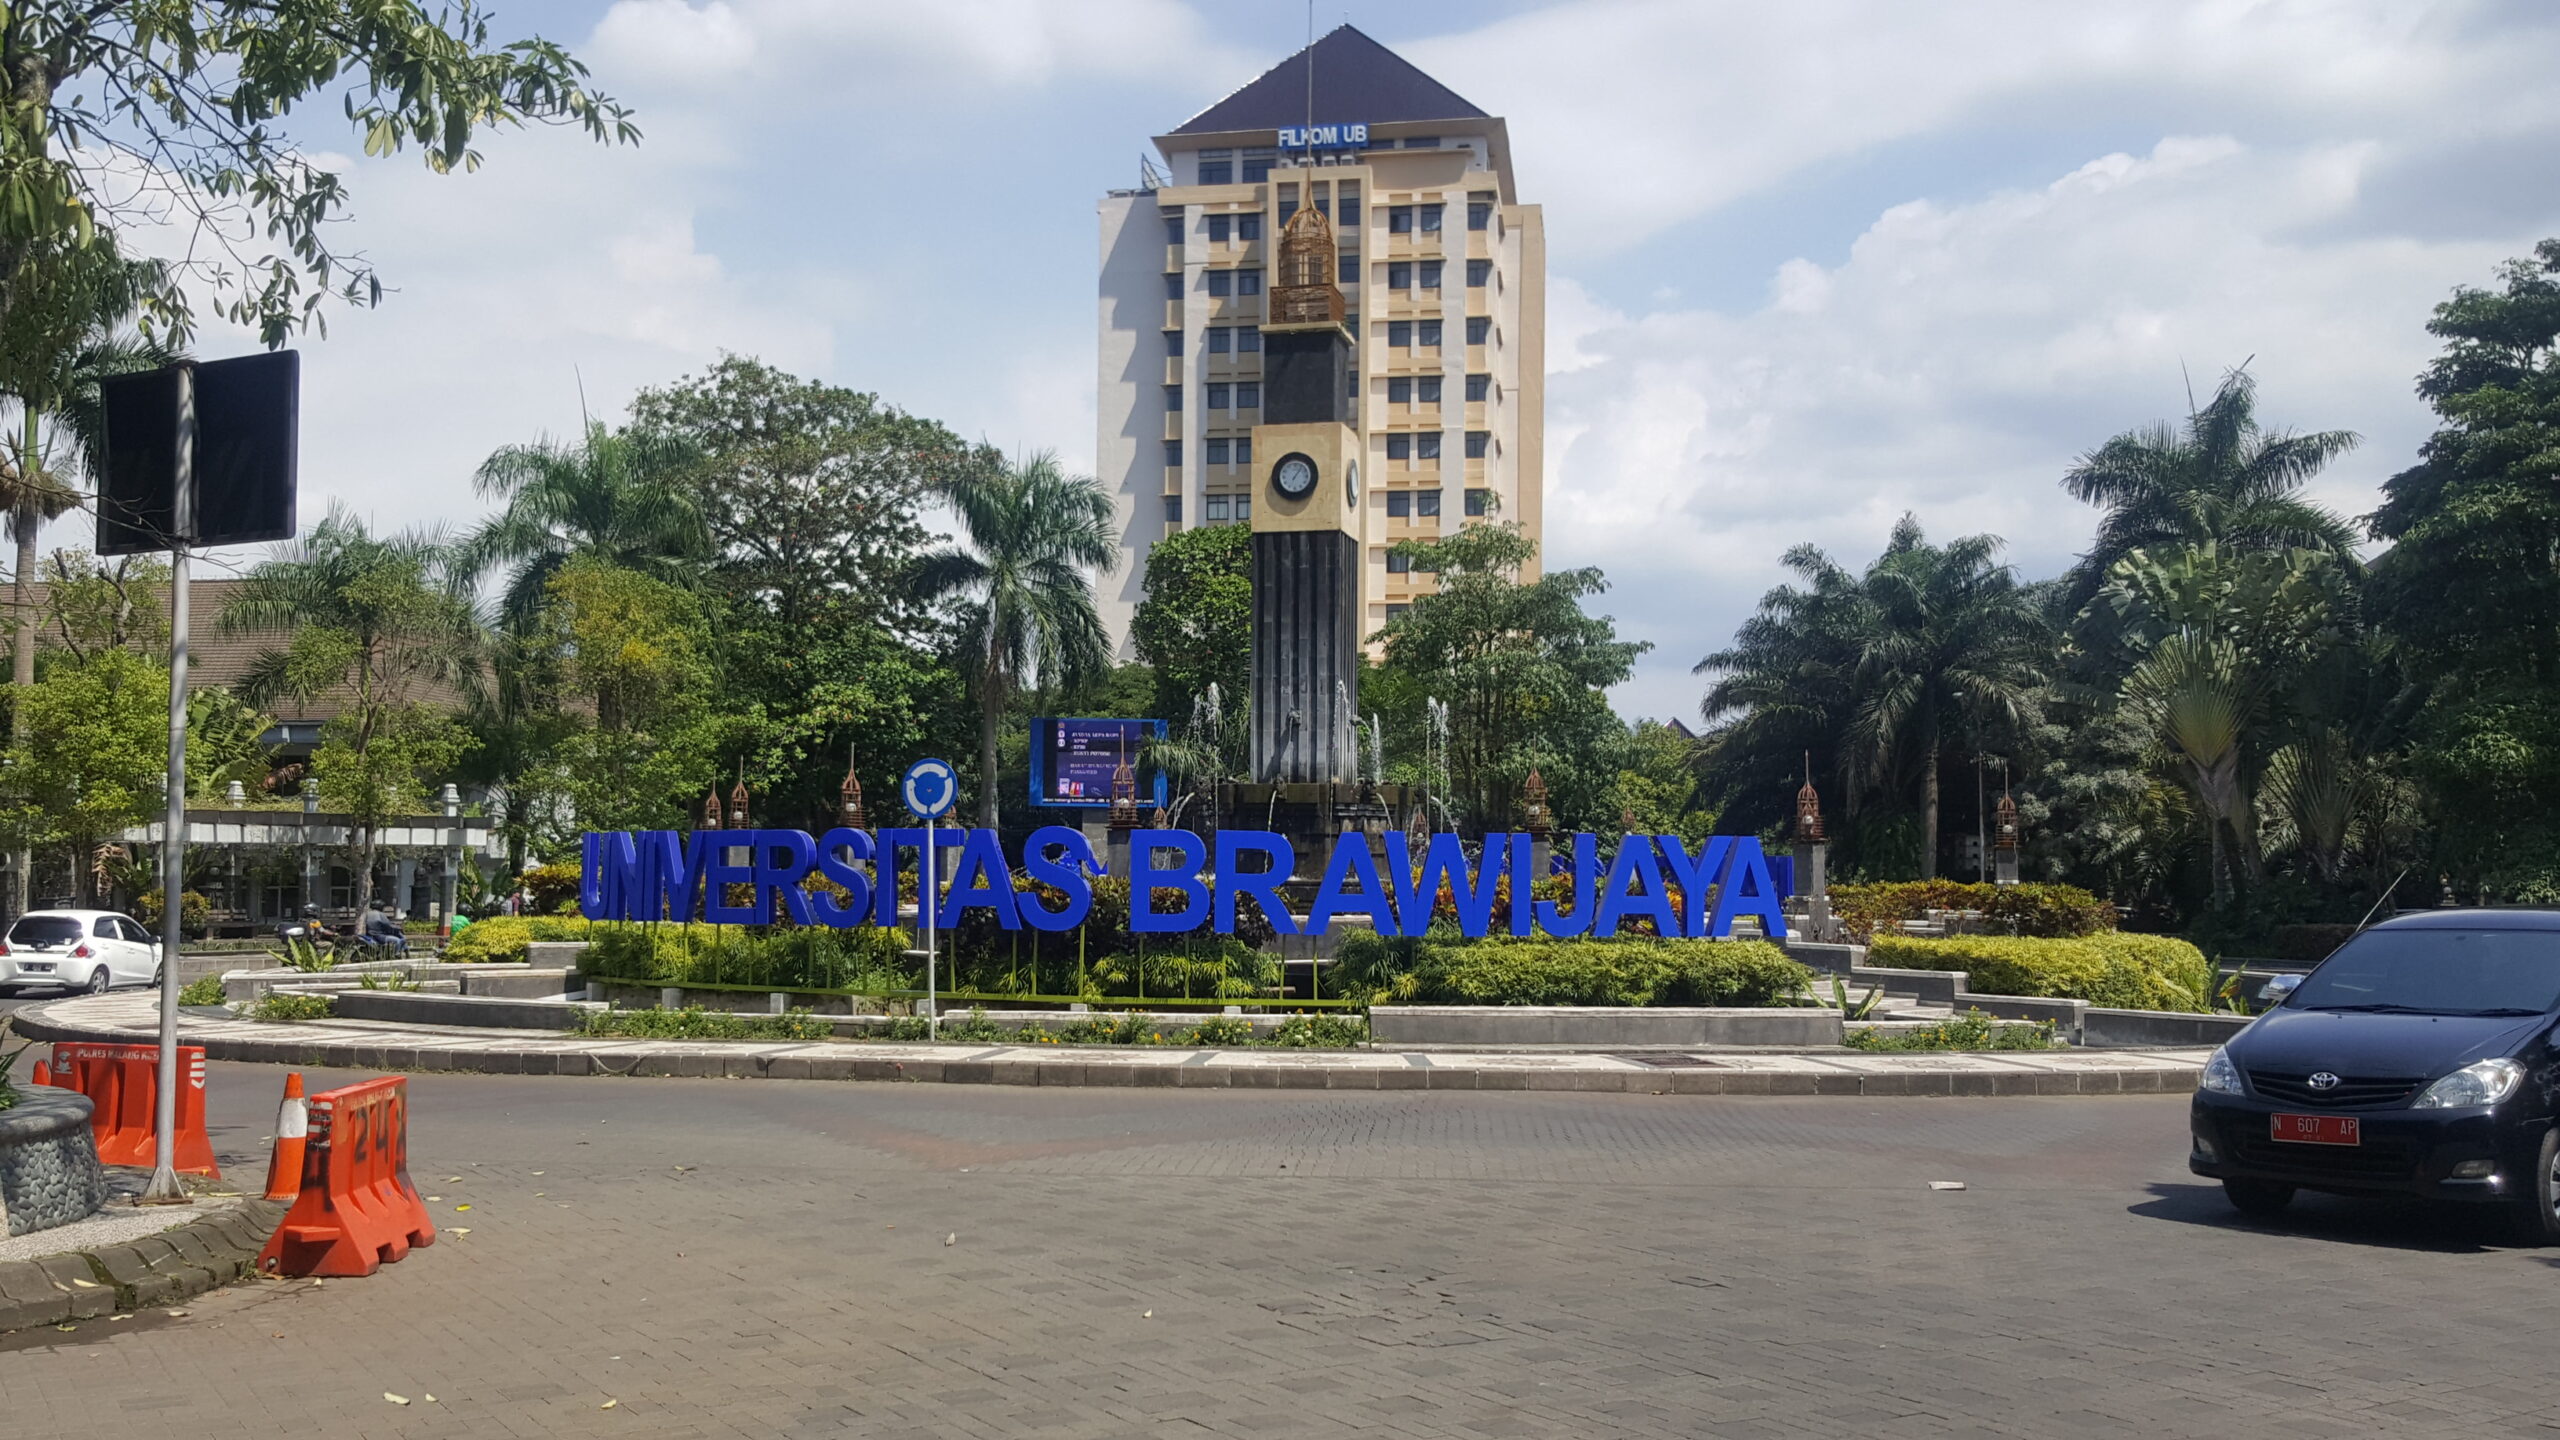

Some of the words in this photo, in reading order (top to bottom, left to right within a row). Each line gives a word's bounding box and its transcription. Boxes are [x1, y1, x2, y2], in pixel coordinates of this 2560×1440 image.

[1278, 127, 1338, 147] FILKOM
[1343, 124, 1367, 143] UB
[580, 825, 1094, 931] UNIVERSITAS
[1129, 829, 1788, 938] BRAWIJAYA
[2273, 1115, 2282, 1131] N
[2297, 1117, 2320, 1134] 607
[2340, 1119, 2356, 1136] AP
